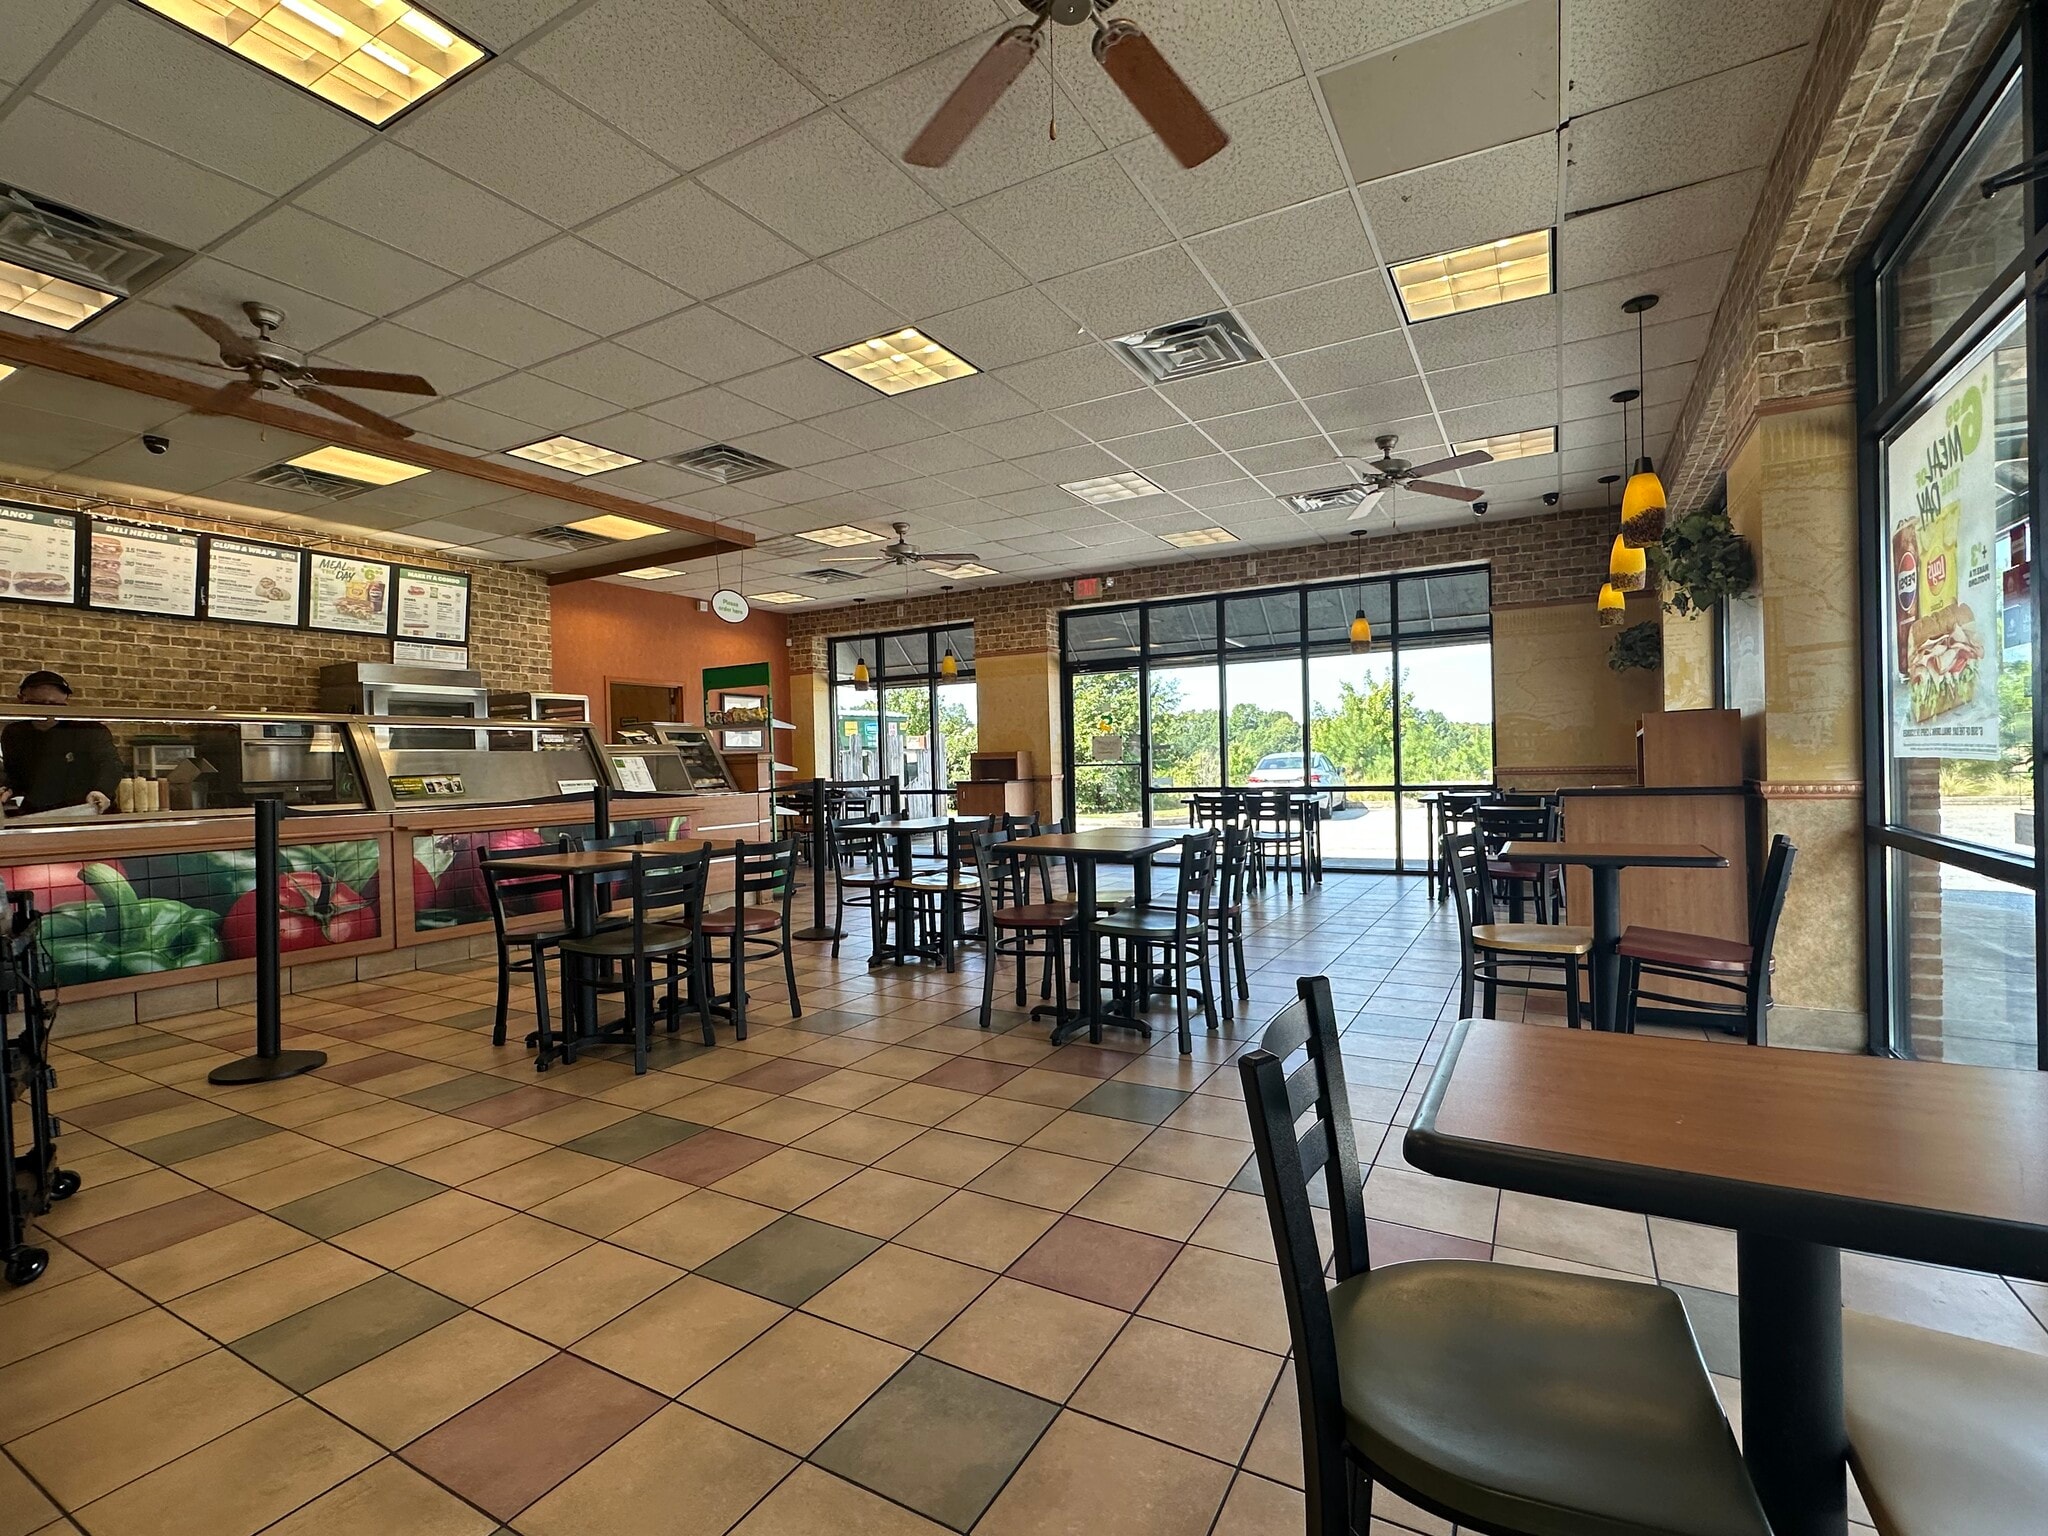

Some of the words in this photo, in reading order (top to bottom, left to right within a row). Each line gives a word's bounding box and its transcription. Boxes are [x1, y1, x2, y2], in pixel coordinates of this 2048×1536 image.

[105, 525, 128, 535] DELI
[129, 529, 168, 541] HEROES
[212, 541, 241, 551] CLUBS
[248, 546, 277, 557] WRAPS
[319, 558, 347, 571] MEAL
[335, 570, 356, 582] DAY
[407, 571, 426, 579] MAKE
[438, 576, 460, 584] COMBO
